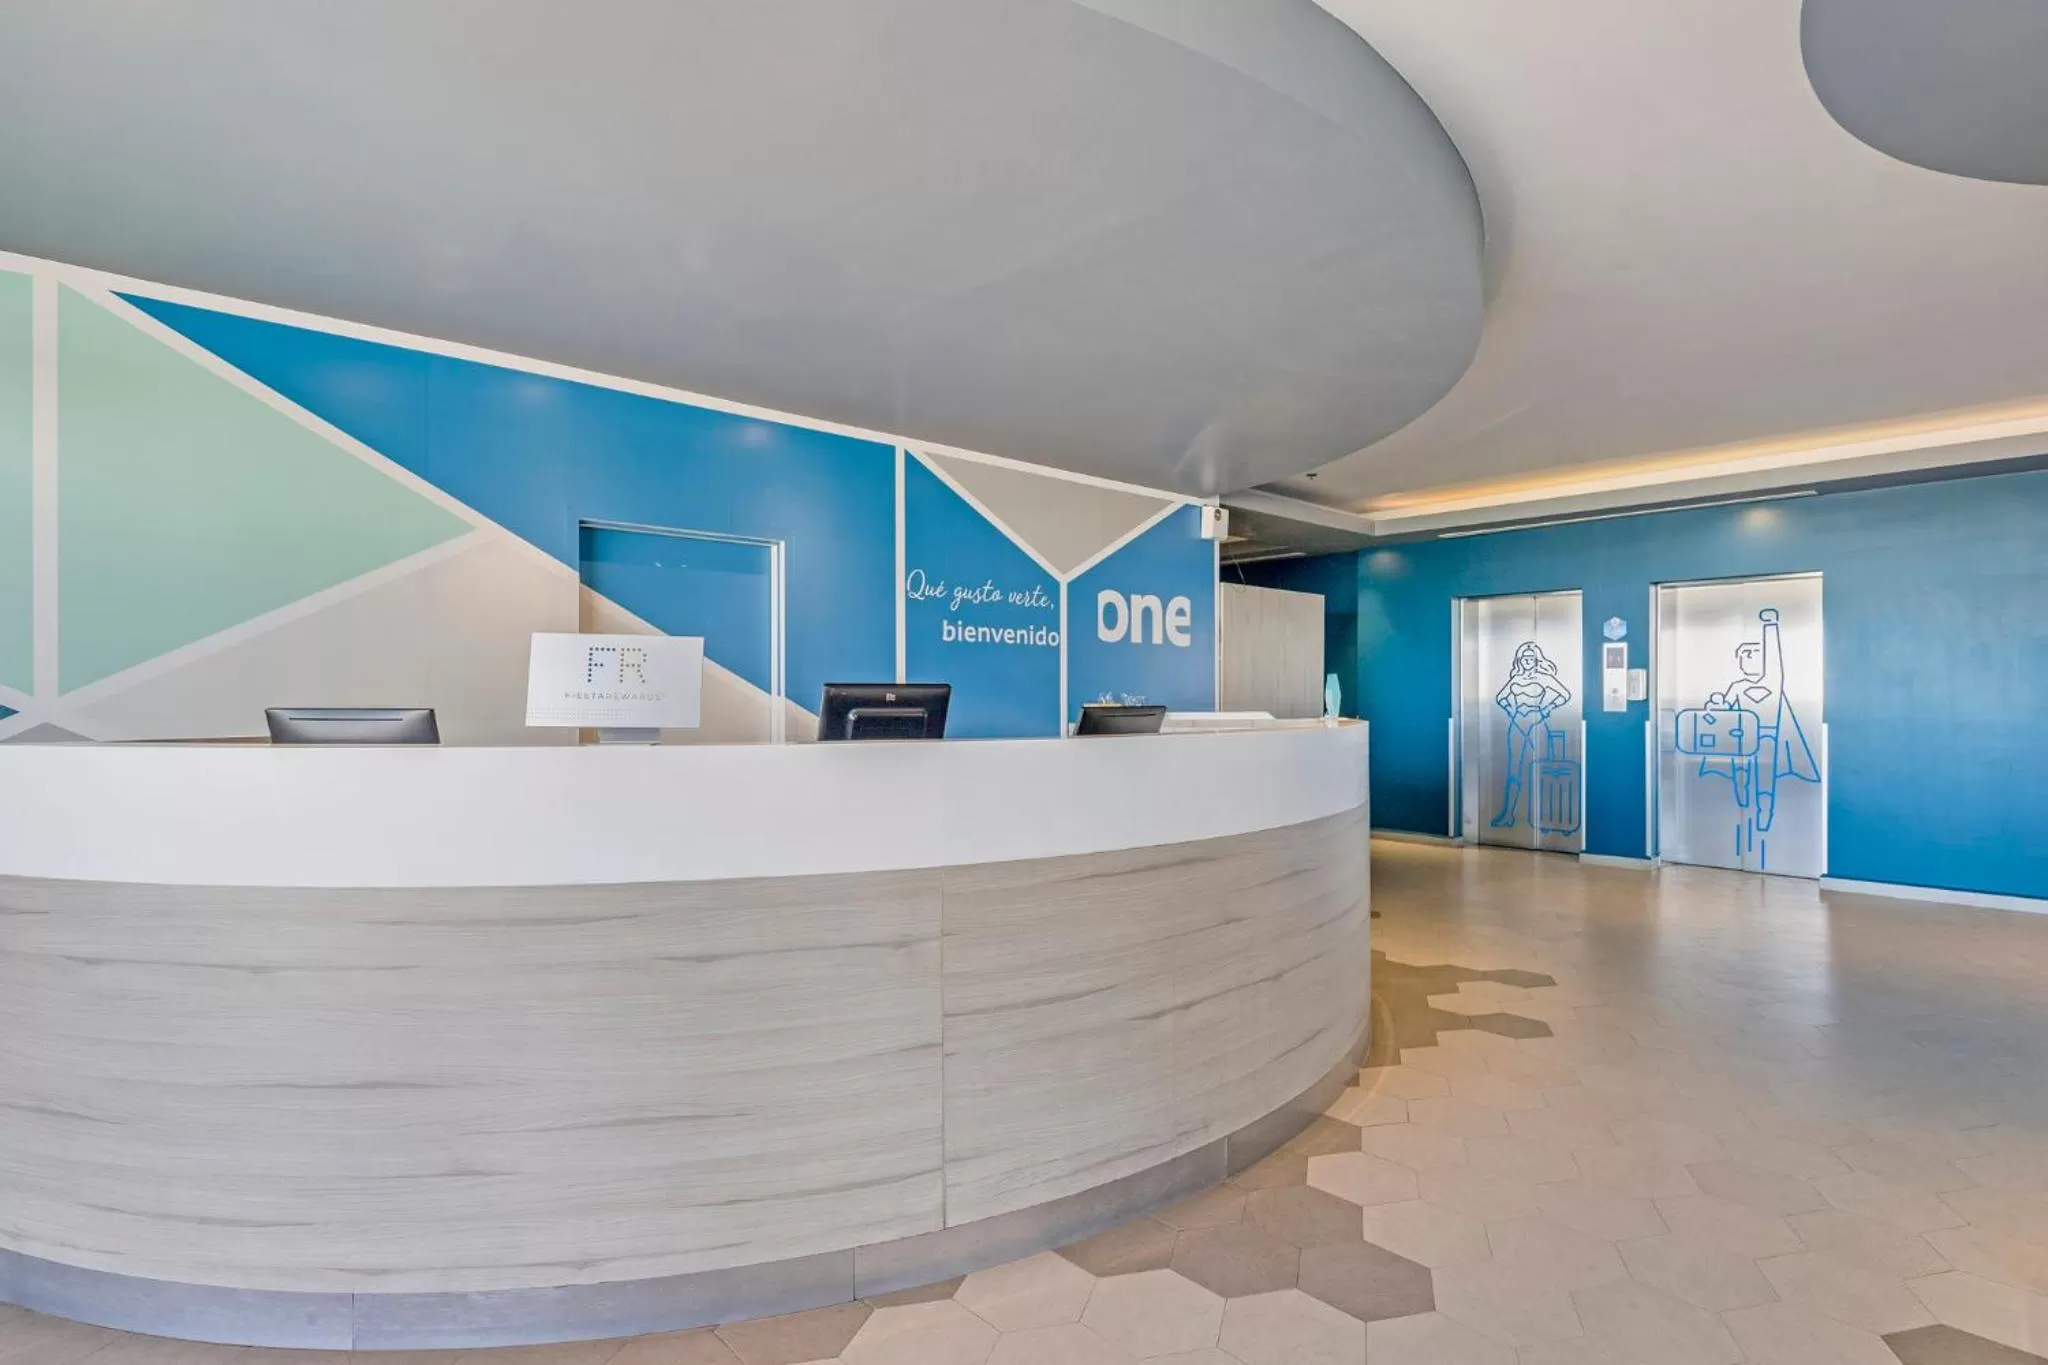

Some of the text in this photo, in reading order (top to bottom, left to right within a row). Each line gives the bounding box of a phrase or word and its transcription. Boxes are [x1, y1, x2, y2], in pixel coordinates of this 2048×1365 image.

[906, 568, 947, 601] Qué
[951, 579, 1003, 611] gusto
[941, 619, 1060, 647] bienvenido
[1096, 588, 1192, 648] one
